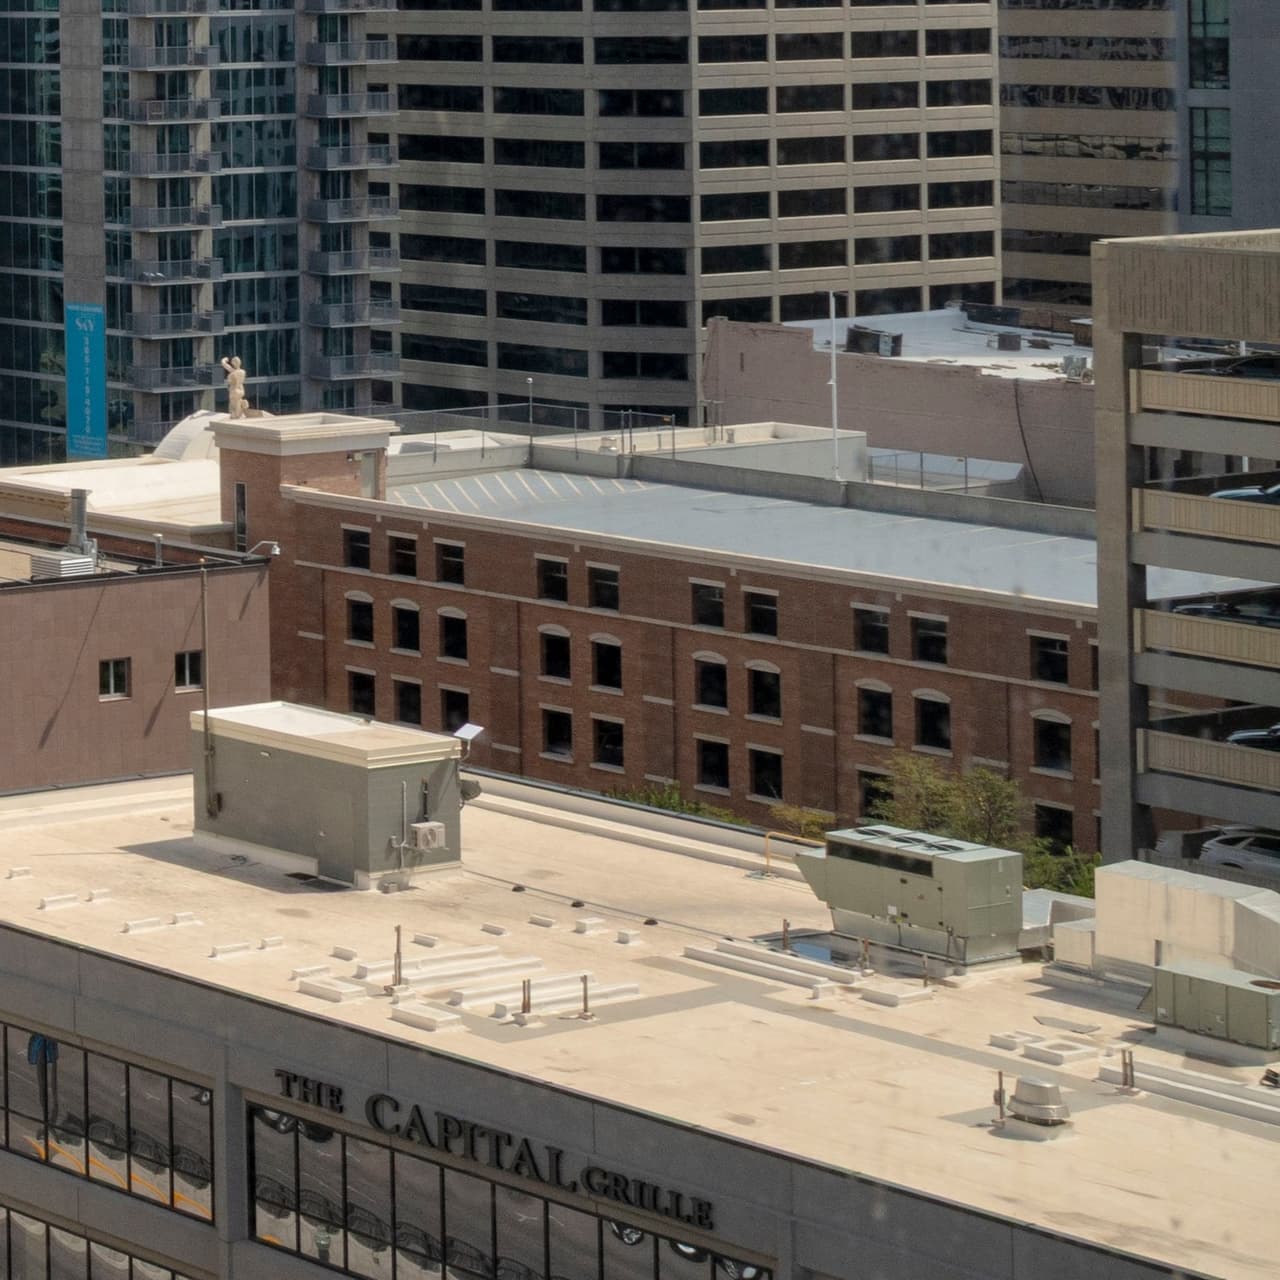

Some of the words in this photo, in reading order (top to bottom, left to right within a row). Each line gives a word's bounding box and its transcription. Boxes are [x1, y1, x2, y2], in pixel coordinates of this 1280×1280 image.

[275, 1068, 345, 1113] THE
[365, 1092, 577, 1193] CAPITAL
[580, 1167, 714, 1230] GRILLE
